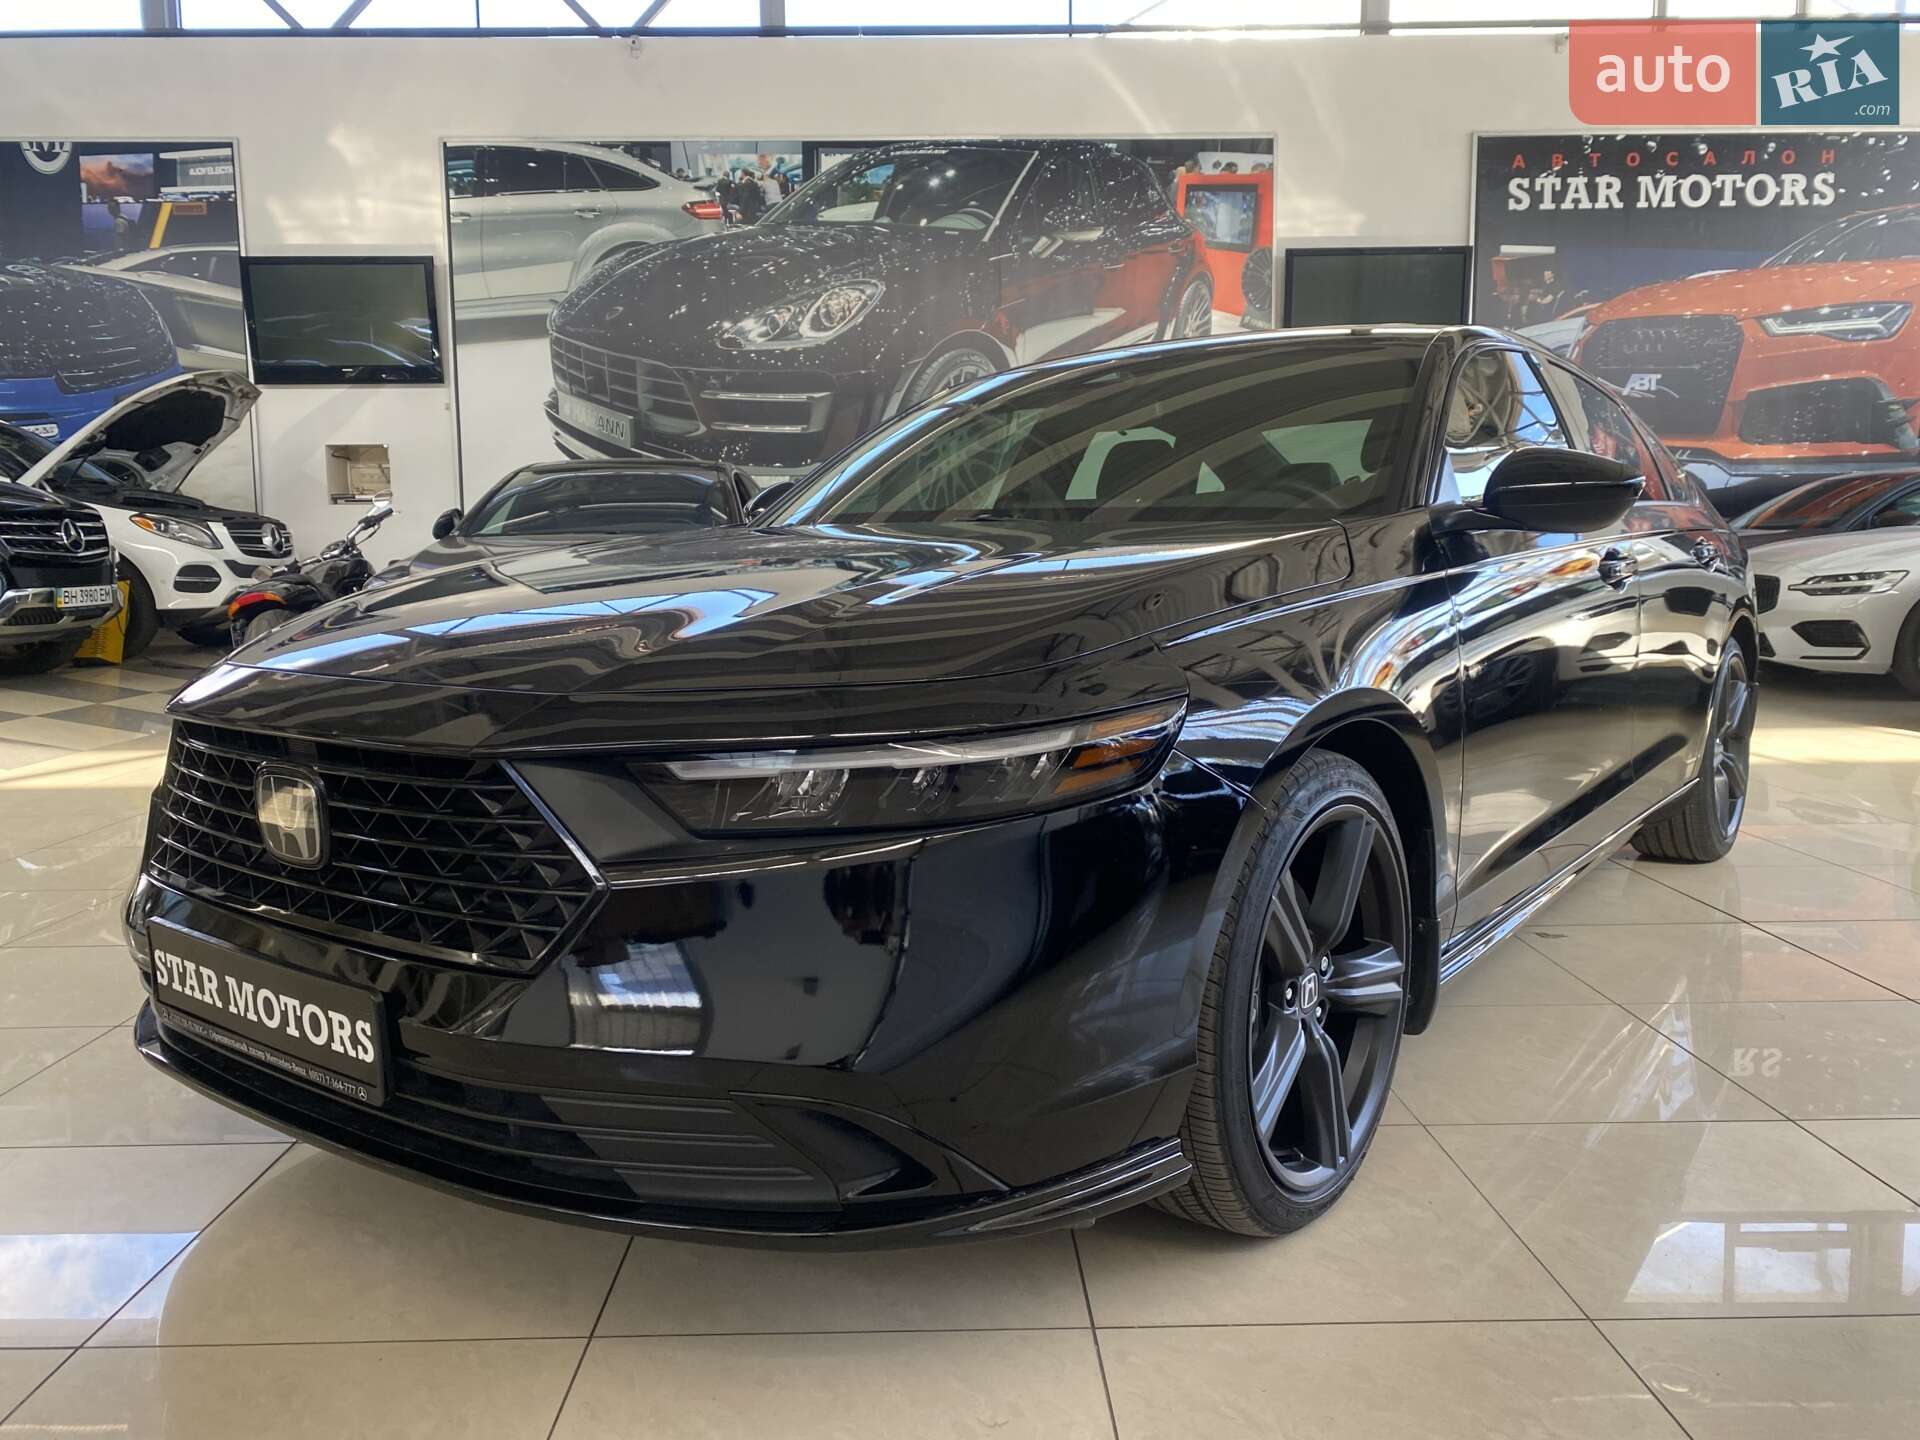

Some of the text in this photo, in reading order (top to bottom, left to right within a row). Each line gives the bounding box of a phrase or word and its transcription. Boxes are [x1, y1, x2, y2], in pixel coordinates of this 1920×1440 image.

[1507, 171, 1836, 212] STAR MOTORS
[63, 590, 78, 605] BH
[99, 588, 111, 602] EM
[154, 949, 375, 1064] STAR MOTORS
